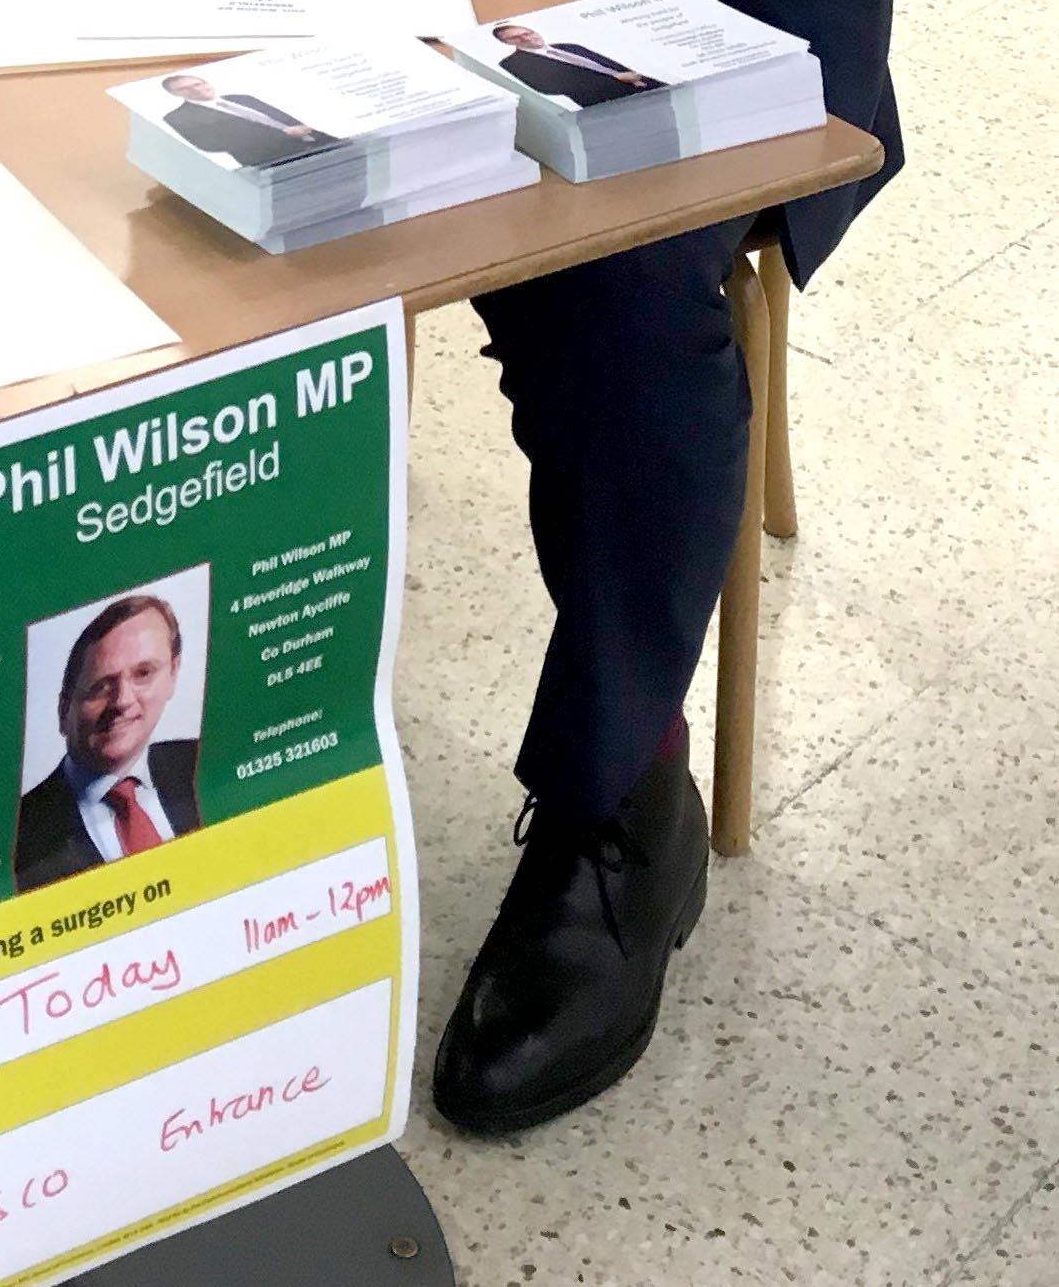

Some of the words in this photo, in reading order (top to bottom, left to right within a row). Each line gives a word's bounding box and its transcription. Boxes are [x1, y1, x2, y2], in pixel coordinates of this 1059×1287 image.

[93, 393, 277, 483] Wilson
[296, 350, 373, 417] MP
[76, 443, 280, 543] Sedgefield
[252, 555, 278, 576] Phil
[281, 541, 325, 566] Wilson
[329, 530, 352, 549] MP
[230, 600, 240, 613] 4
[243, 577, 310, 610] Beveridge
[312, 556, 371, 585] Walkway
[249, 610, 298, 637] Newton
[302, 591, 351, 619] Aycliffe
[261, 646, 279, 661] Co
[283, 626, 334, 654] Durham
[296, 655, 323, 675] 4EE
[253, 709, 323, 743] Telephone:
[237, 751, 283, 780] 01325
[285, 731, 338, 762] 321603
[30, 925, 45, 946] a
[51, 891, 137, 940] surgery
[143, 878, 172, 901] on
[159, 1064, 332, 1153] Entrance
